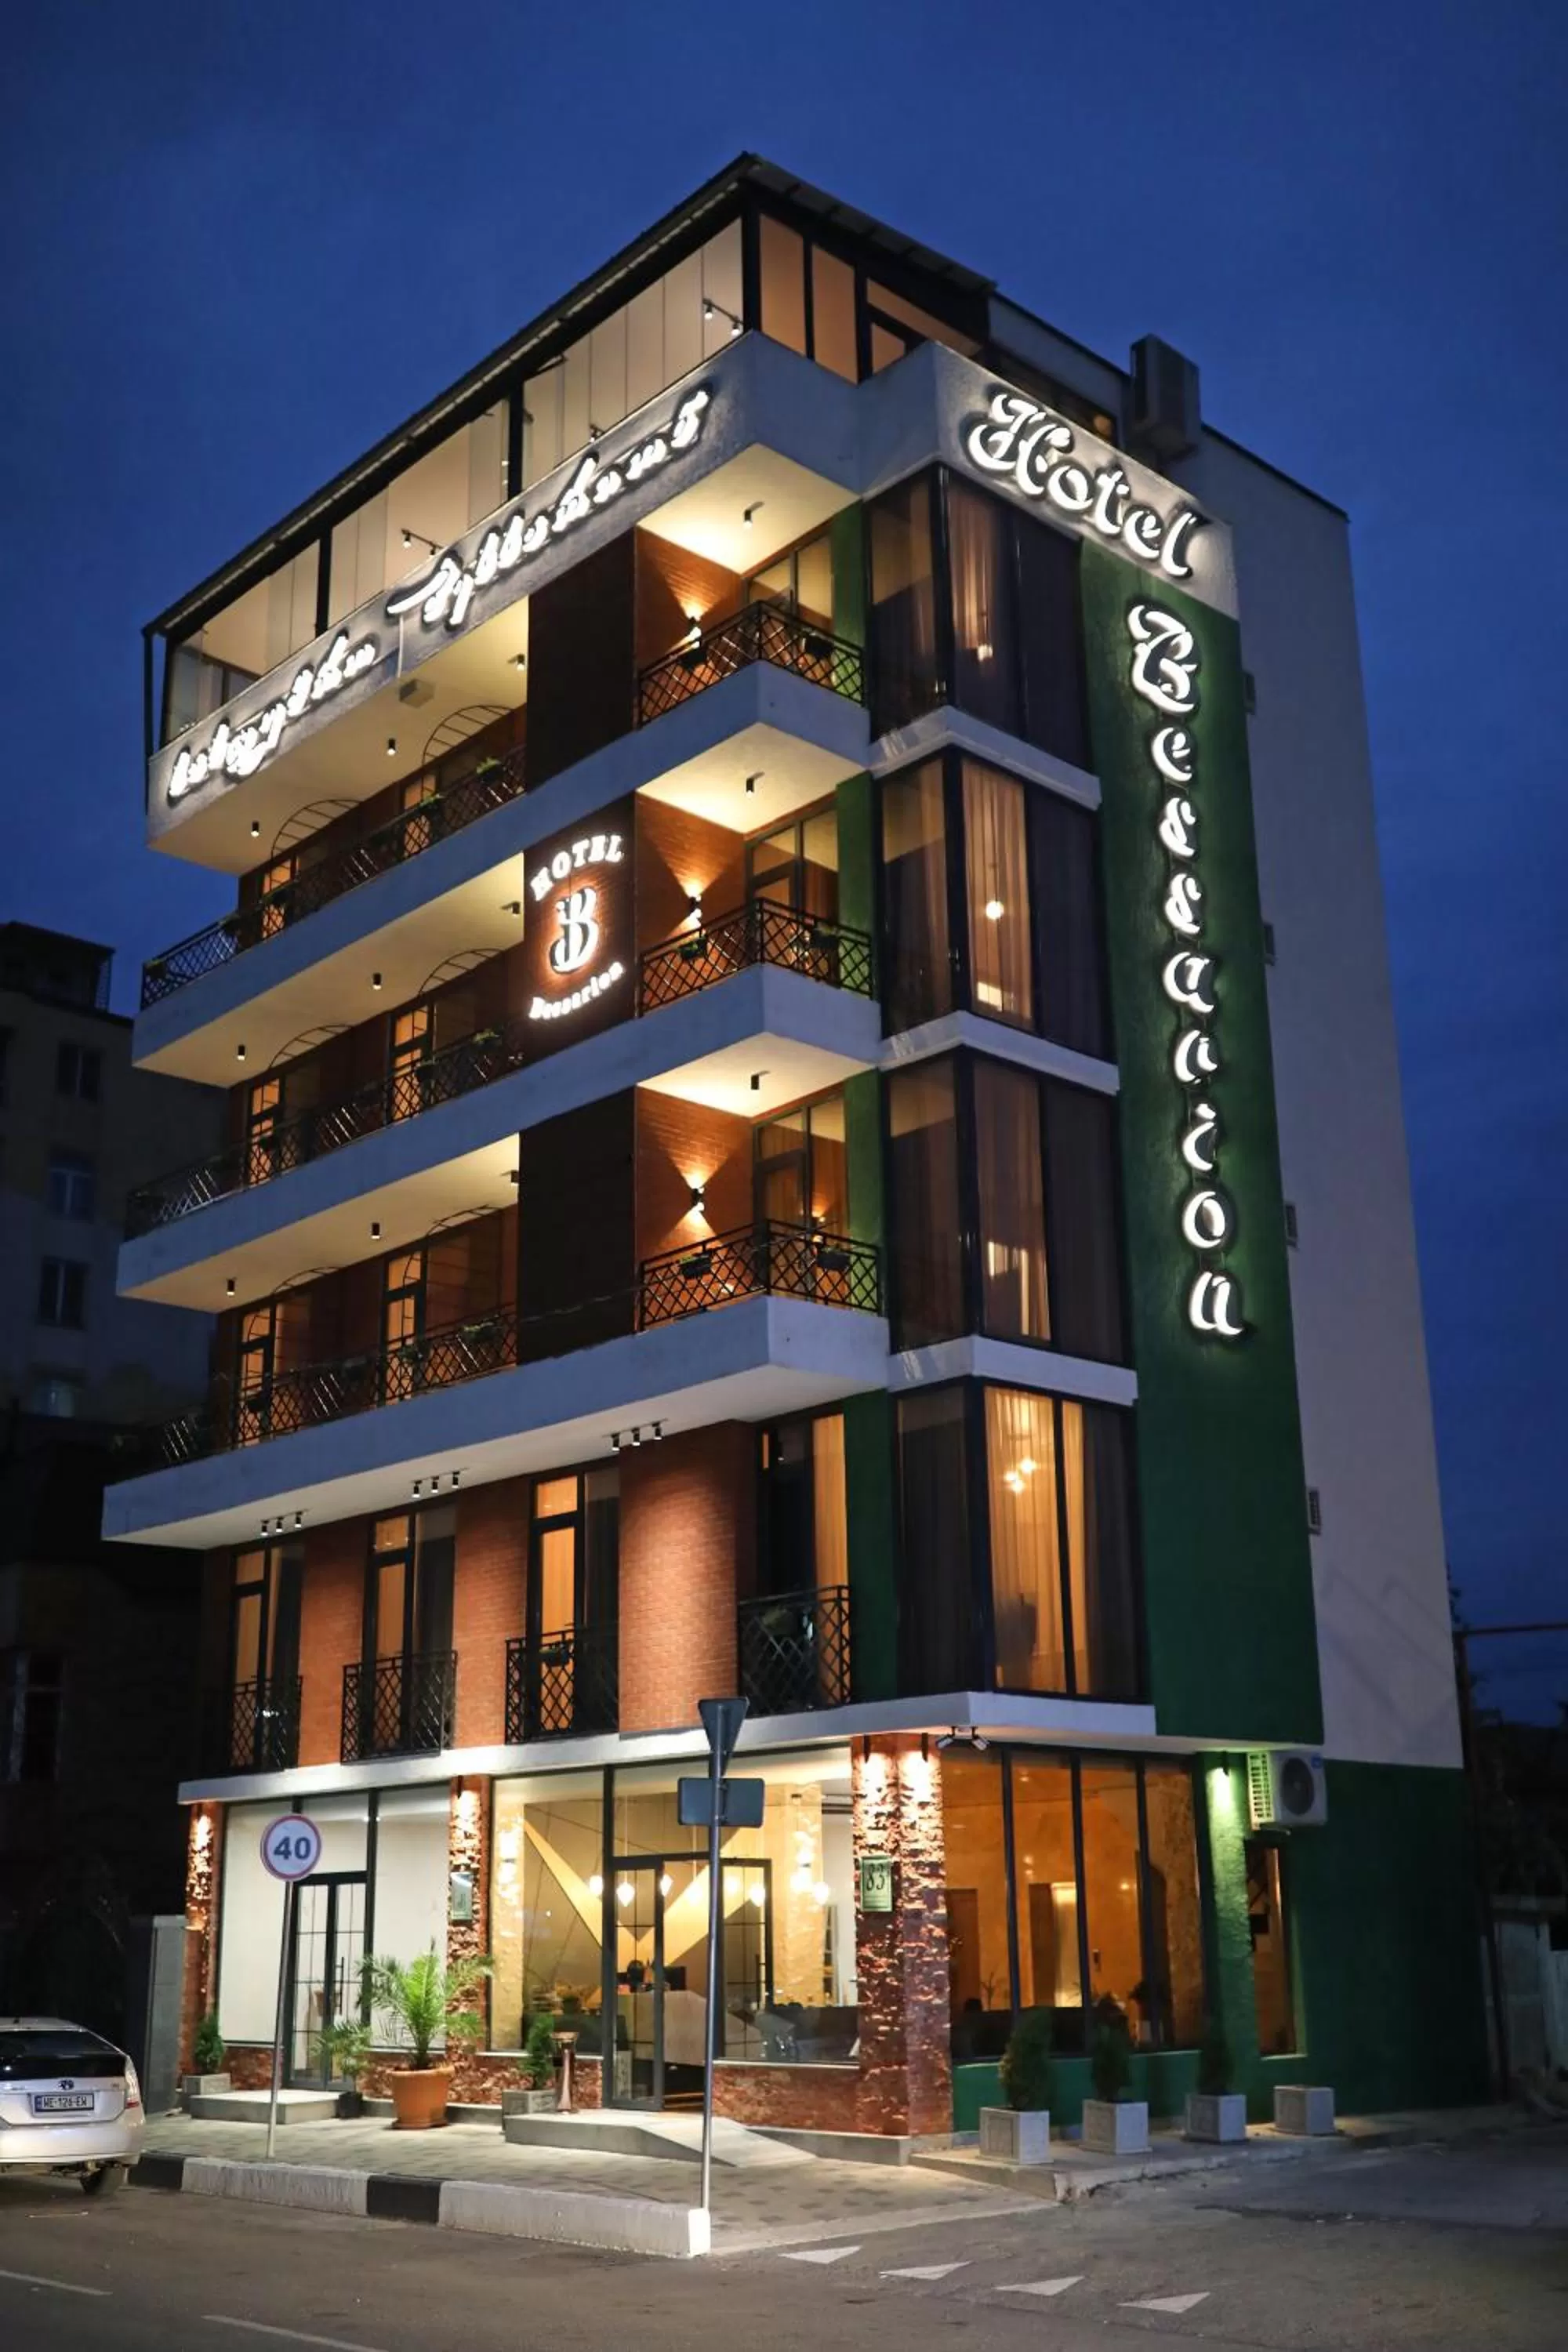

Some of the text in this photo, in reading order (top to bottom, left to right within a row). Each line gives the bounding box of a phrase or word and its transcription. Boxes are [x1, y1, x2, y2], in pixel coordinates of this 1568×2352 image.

[968, 393, 1200, 577] Hotel
[529, 833, 624, 902] HOTEL
[1127, 604, 1242, 1336] Bessarion
[273, 1835, 311, 1860] 40
[866, 1863, 885, 1891] 83
